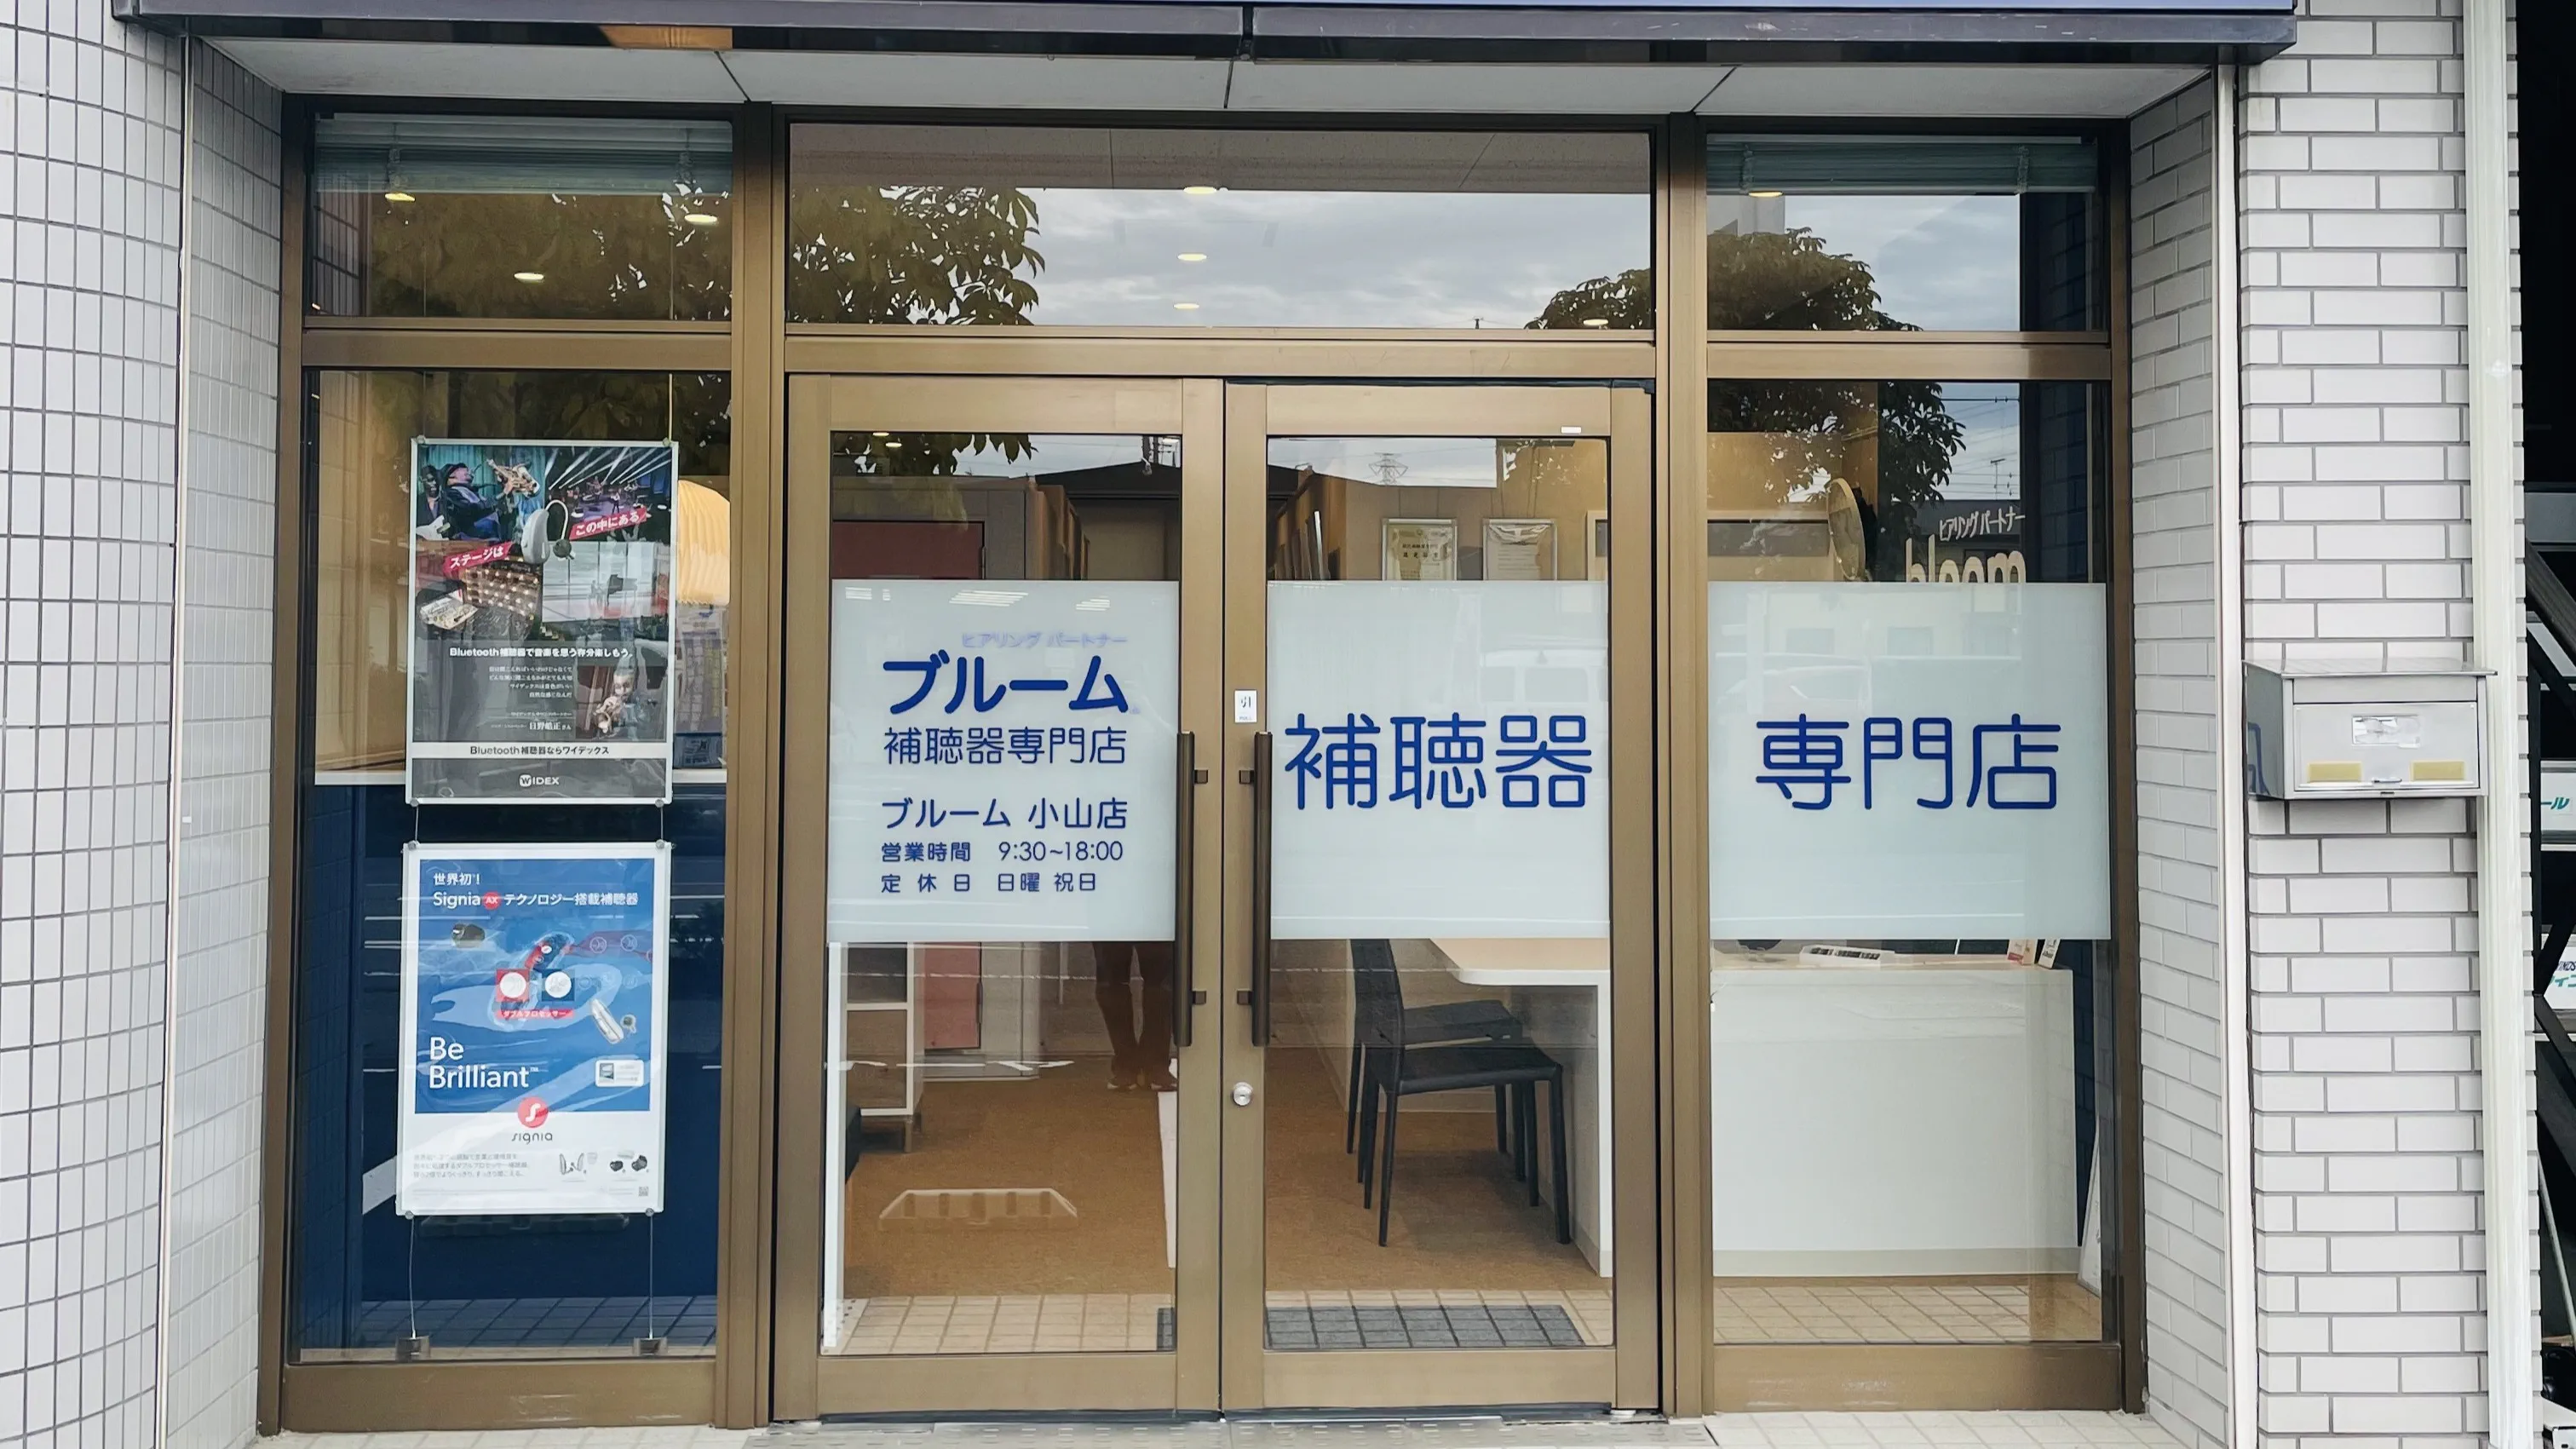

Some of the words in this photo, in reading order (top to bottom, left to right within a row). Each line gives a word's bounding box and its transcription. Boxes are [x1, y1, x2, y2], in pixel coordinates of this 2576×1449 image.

[575, 512, 640, 537] この中にある
[1940, 506, 2026, 542] ヒアリングパートナー
[450, 545, 505, 568] ステージは
[883, 649, 1129, 715] ブルーム
[883, 727, 1128, 764] 補聴器専門店
[1285, 712, 1592, 810] 補聴器
[1756, 713, 2061, 810] 専門店
[520, 774, 560, 787] WIDEX
[882, 797, 1011, 829] ブルーム
[1028, 797, 1128, 830] 小山店
[882, 842, 971, 862] 営業時間
[433, 892, 480, 909] Signia
[429, 1037, 464, 1061] Be
